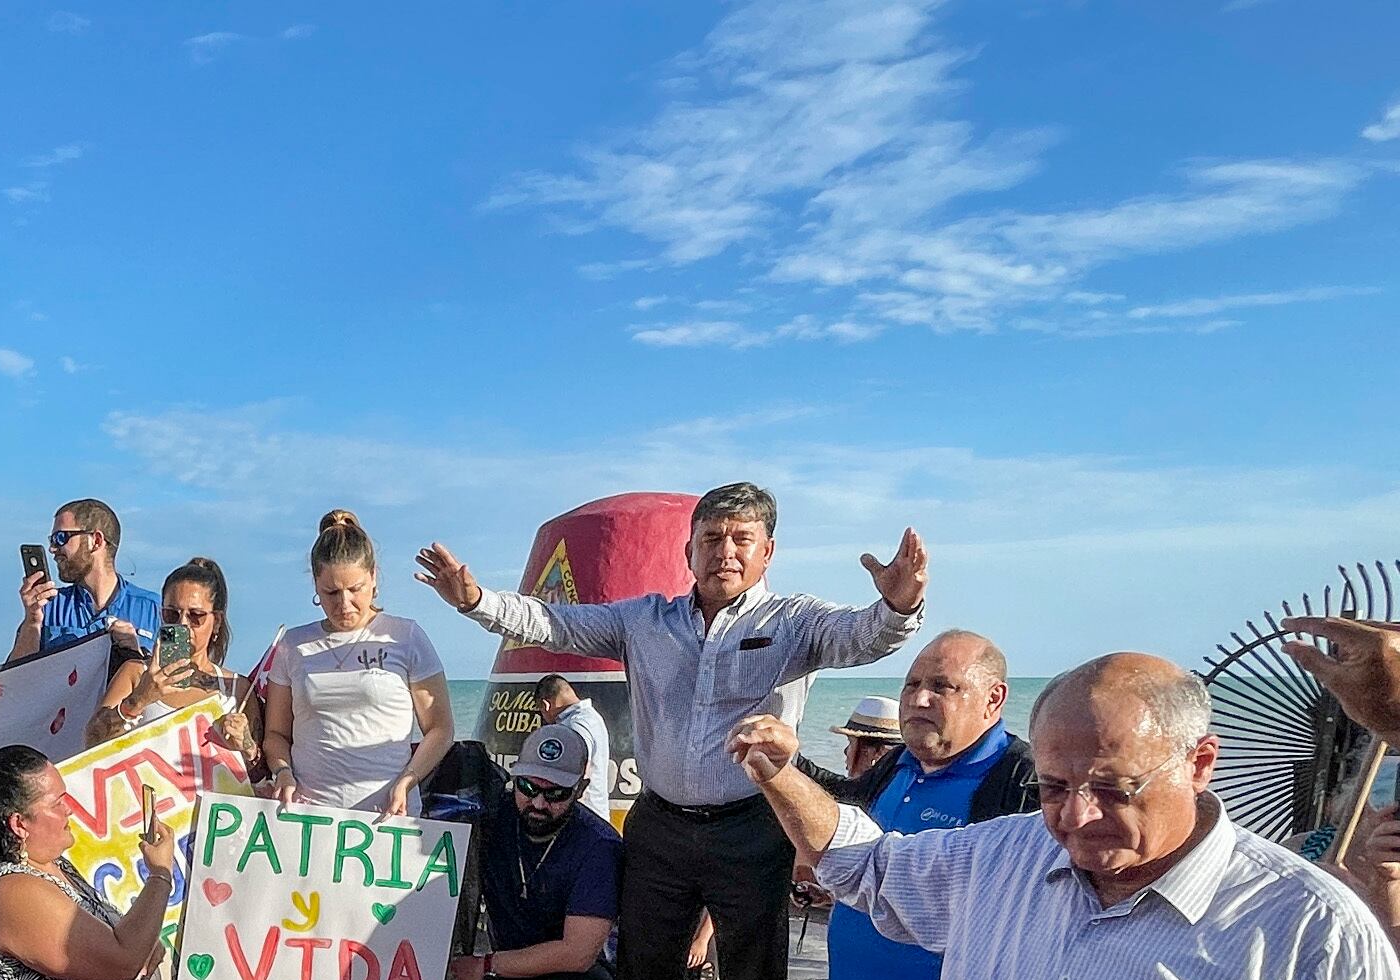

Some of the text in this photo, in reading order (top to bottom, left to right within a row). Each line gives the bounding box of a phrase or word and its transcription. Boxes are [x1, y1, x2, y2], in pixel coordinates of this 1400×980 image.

[489, 691, 509, 711] 90
[495, 711, 542, 732] CUBA
[62, 714, 247, 838] VIVA
[203, 803, 458, 897] PATRIA
